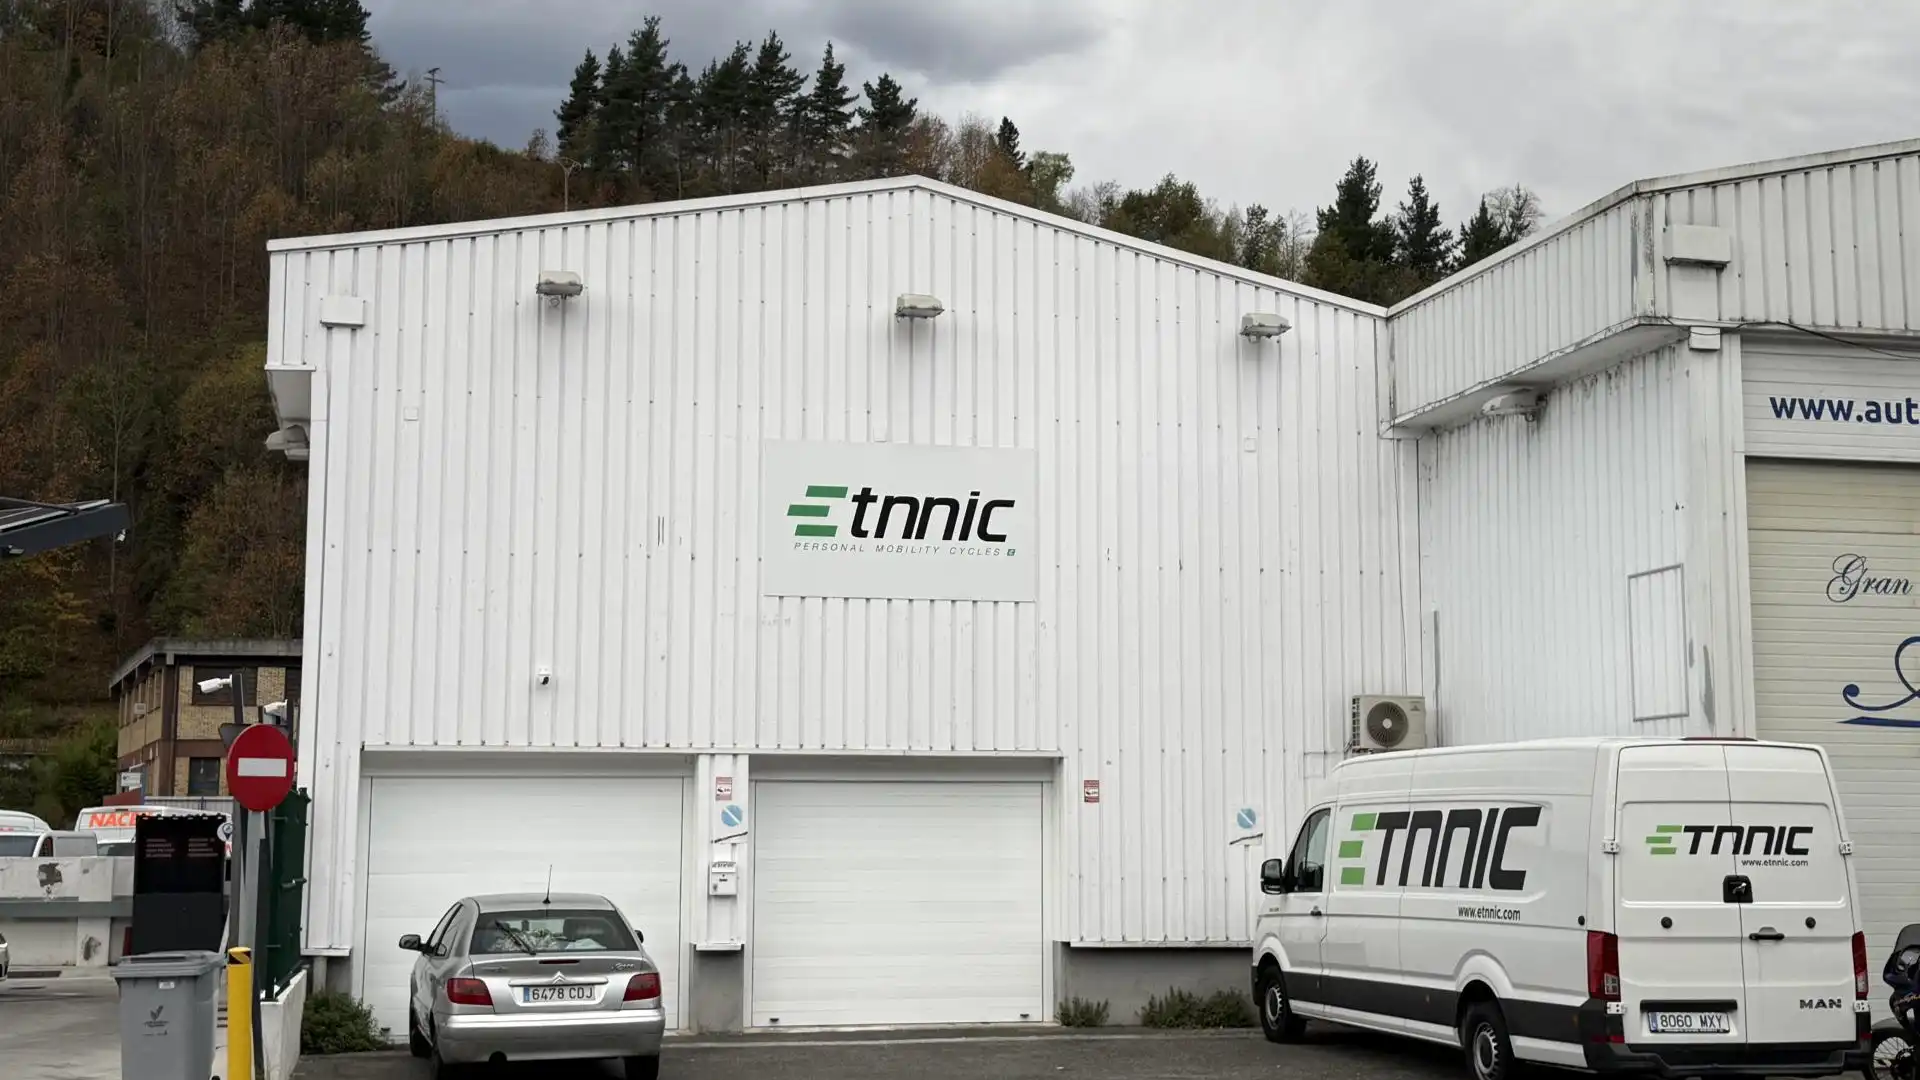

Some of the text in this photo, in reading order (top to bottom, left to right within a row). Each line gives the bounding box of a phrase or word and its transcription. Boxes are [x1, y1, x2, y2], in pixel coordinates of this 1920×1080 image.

[1770, 397, 1919, 424] www.aut
[787, 485, 1015, 542] Etnnic
[794, 542, 865, 552] PERSONAL
[876, 545, 940, 554] MOBILITY
[949, 547, 1001, 556] CYCLES
[1826, 553, 1913, 603] Gran
[1741, 858, 1809, 867] www.etnnic.com
[1458, 905, 1521, 921] www.etnnic.com
[532, 987, 593, 1000] 6478 CDJ
[1799, 998, 1842, 1009] MAN
[1660, 1014, 1723, 1028] 8060 MXY
